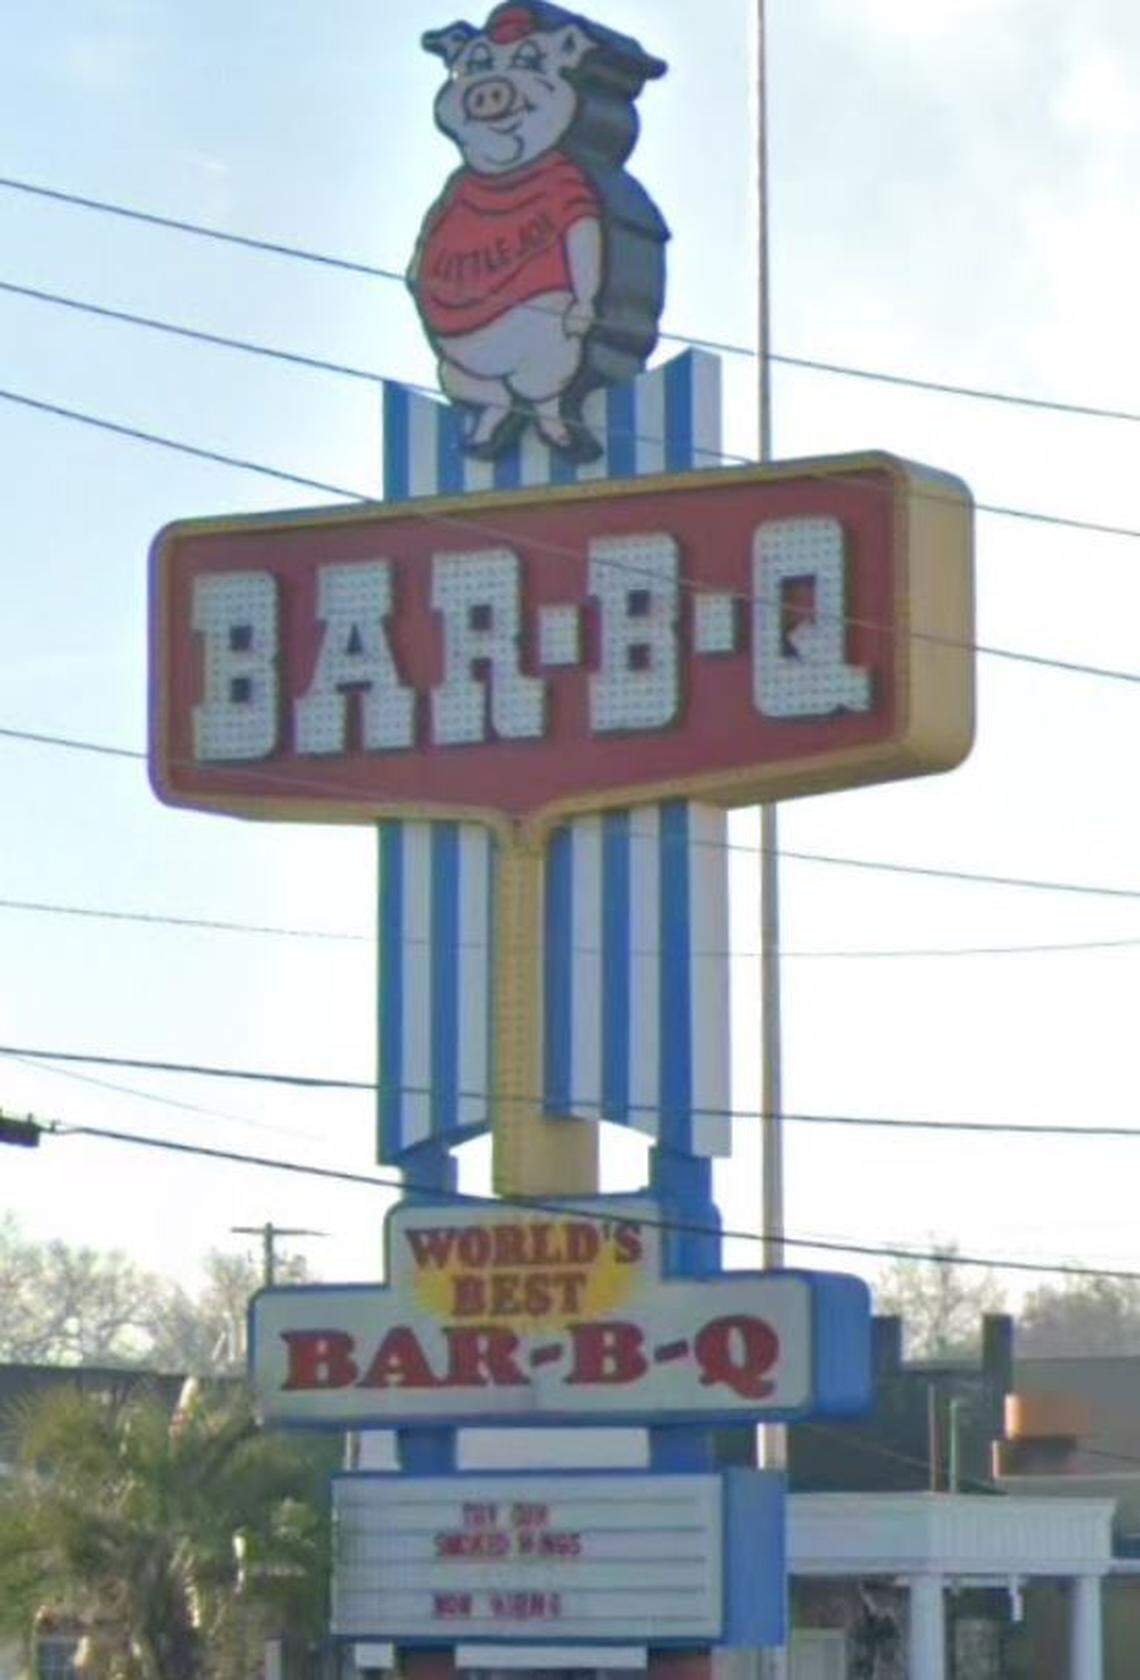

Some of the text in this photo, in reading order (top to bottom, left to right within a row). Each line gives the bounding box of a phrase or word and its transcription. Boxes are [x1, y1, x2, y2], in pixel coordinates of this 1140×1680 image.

[189, 515, 872, 762] BAR-B-Q
[404, 1221, 643, 1270] WORLD'S
[450, 1271, 588, 1317] BEST
[280, 1314, 780, 1399] BAR-B-Q
